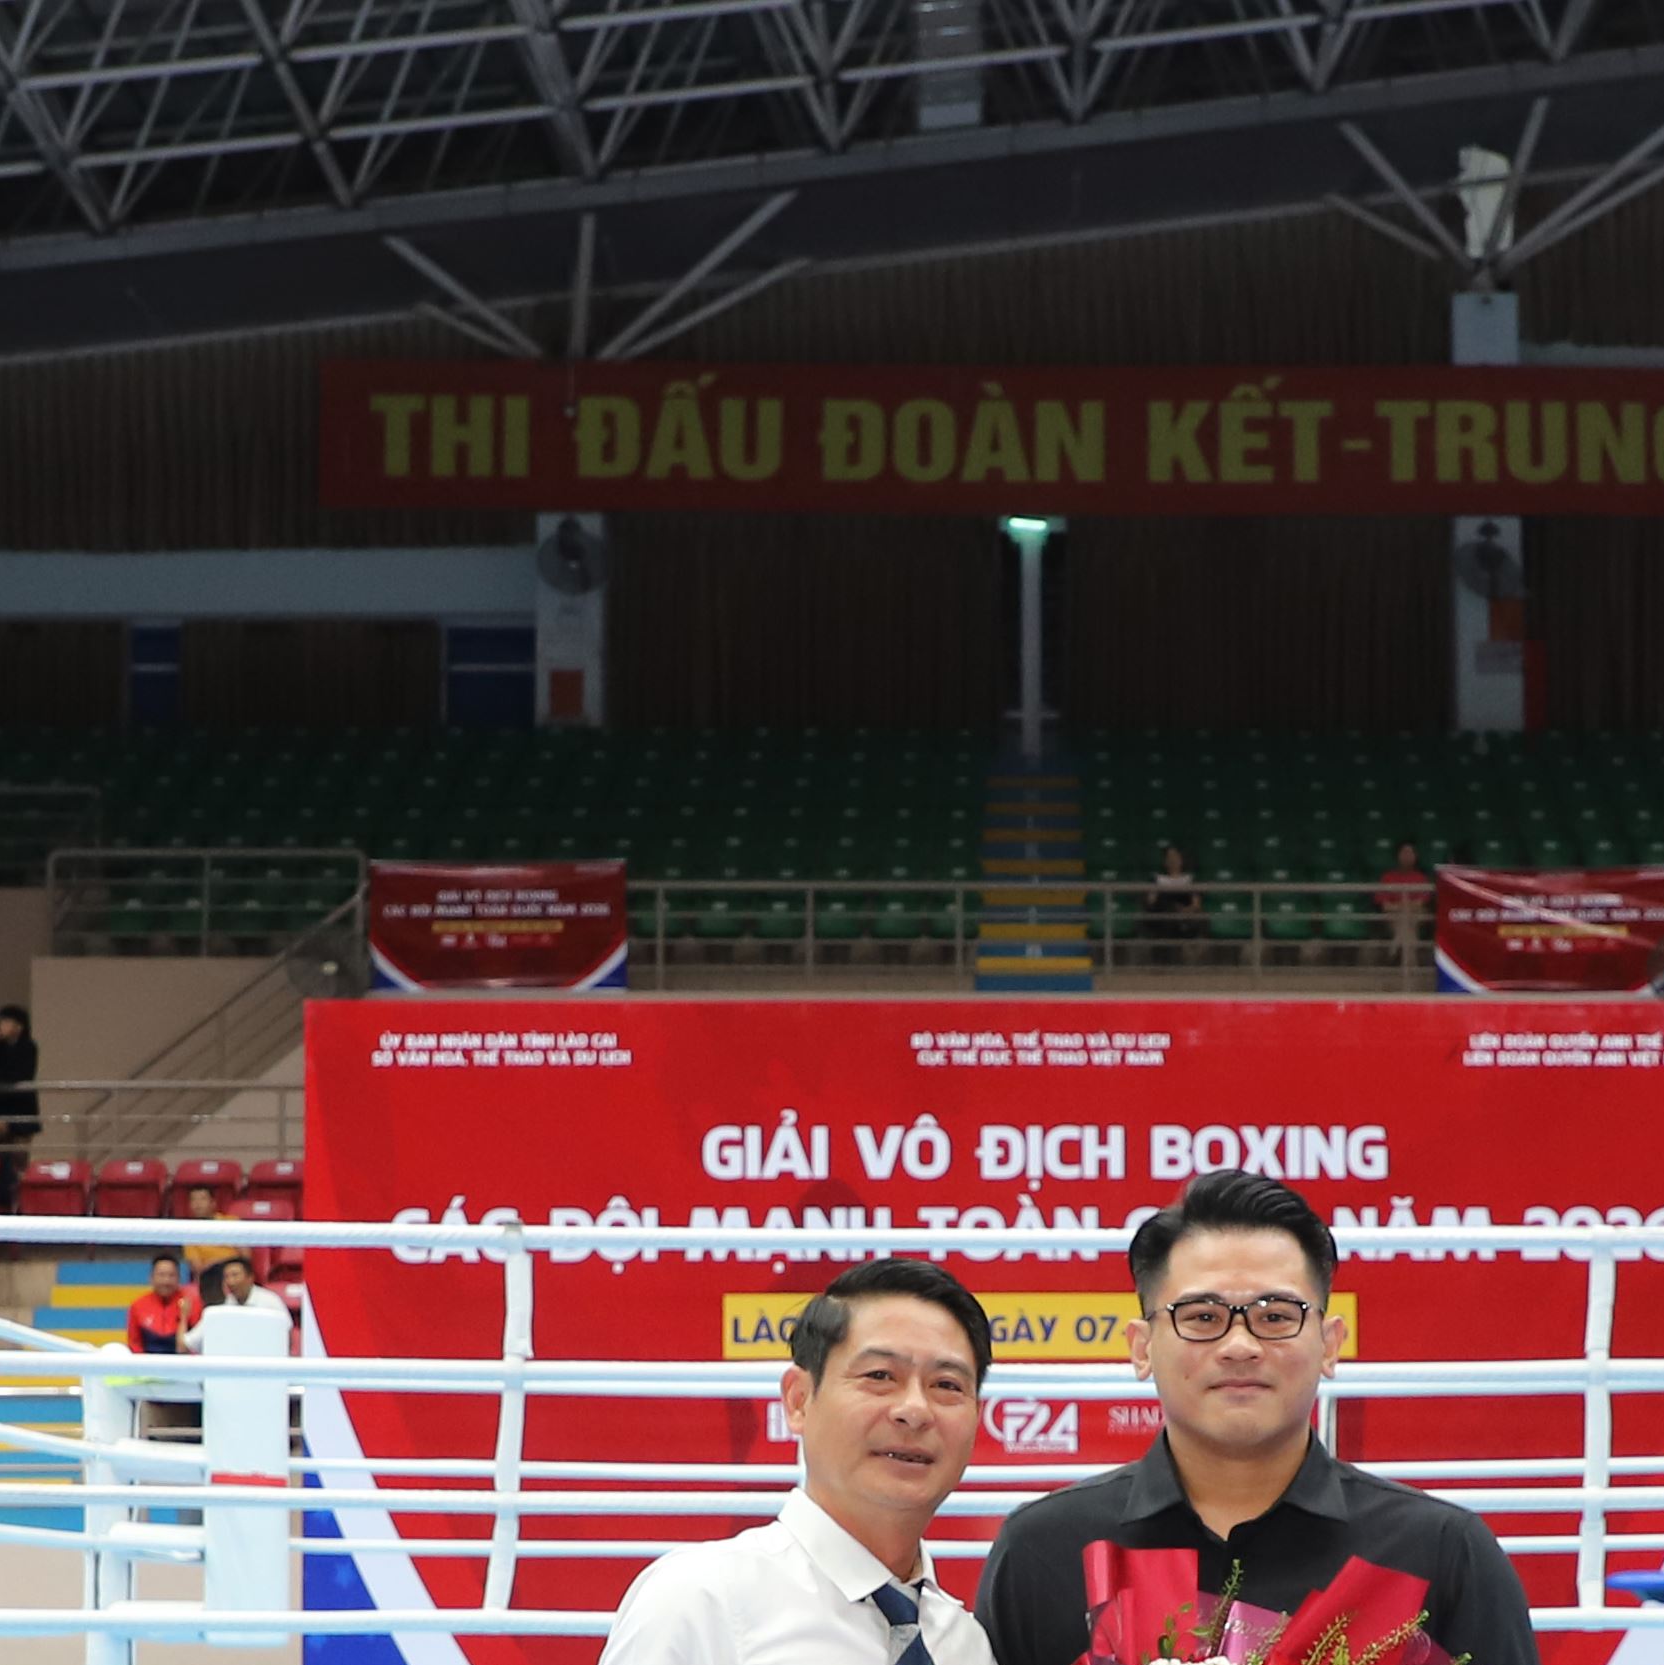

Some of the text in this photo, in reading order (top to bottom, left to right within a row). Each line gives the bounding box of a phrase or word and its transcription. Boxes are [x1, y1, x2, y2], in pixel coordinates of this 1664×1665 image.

[370, 393, 530, 477] THI
[573, 372, 785, 481] ĐẤU
[818, 381, 1105, 482] ĐOÀN
[702, 1109, 1389, 1191] GIẢI VÔ ĐỊCH BOXING
[989, 1311, 1129, 1343] GÀY 07-
